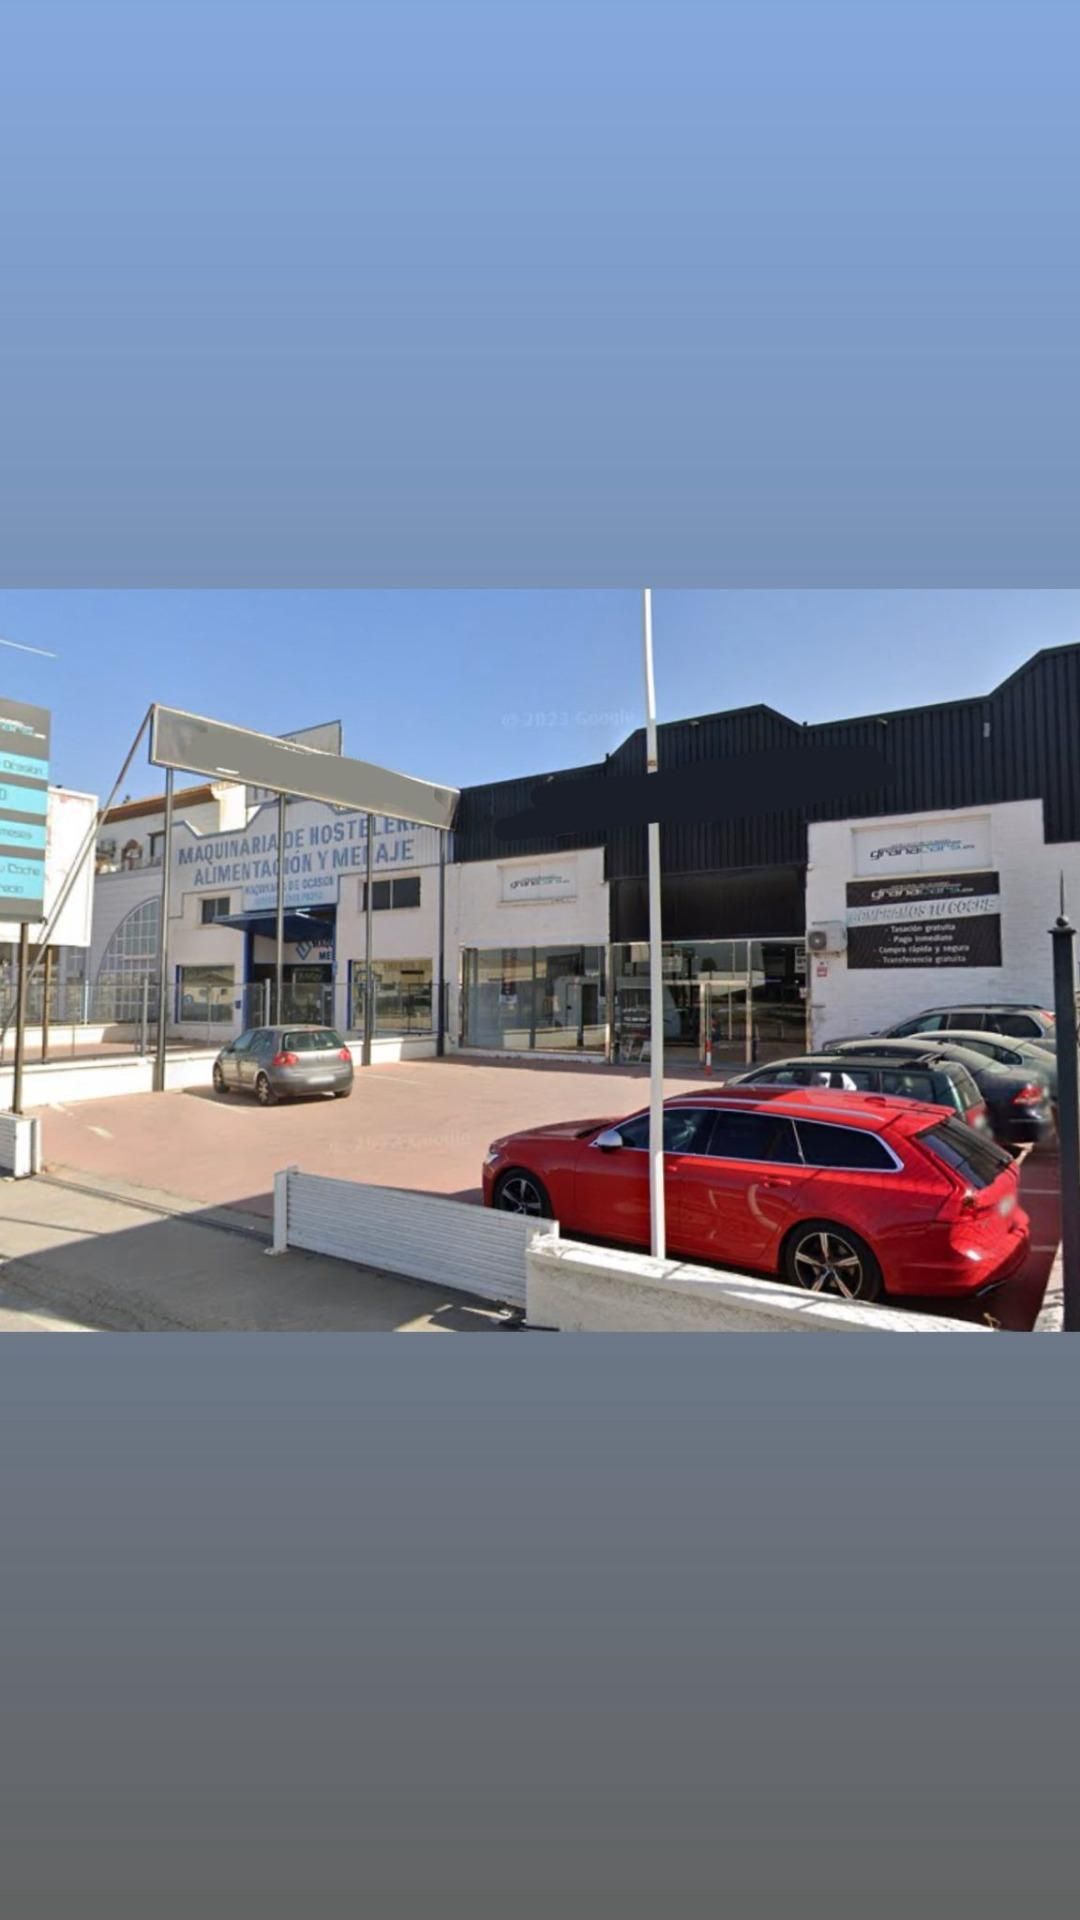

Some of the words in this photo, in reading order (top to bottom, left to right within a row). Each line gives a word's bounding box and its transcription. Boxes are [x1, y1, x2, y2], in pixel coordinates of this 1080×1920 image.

[178, 834, 278, 865] MAQUINARIA
[284, 828, 304, 849] DE
[194, 849, 312, 886] ALIMENTACIÓN
[318, 849, 328, 870] Y
[891, 923, 923, 933] Tasación
[925, 922, 956, 934] gratuita
[893, 935, 913, 944] Pago
[879, 946, 906, 955] Compra
[943, 944, 970, 953] segura
[882, 955, 932, 964] Transferencia
[935, 955, 967, 964] gratuita
